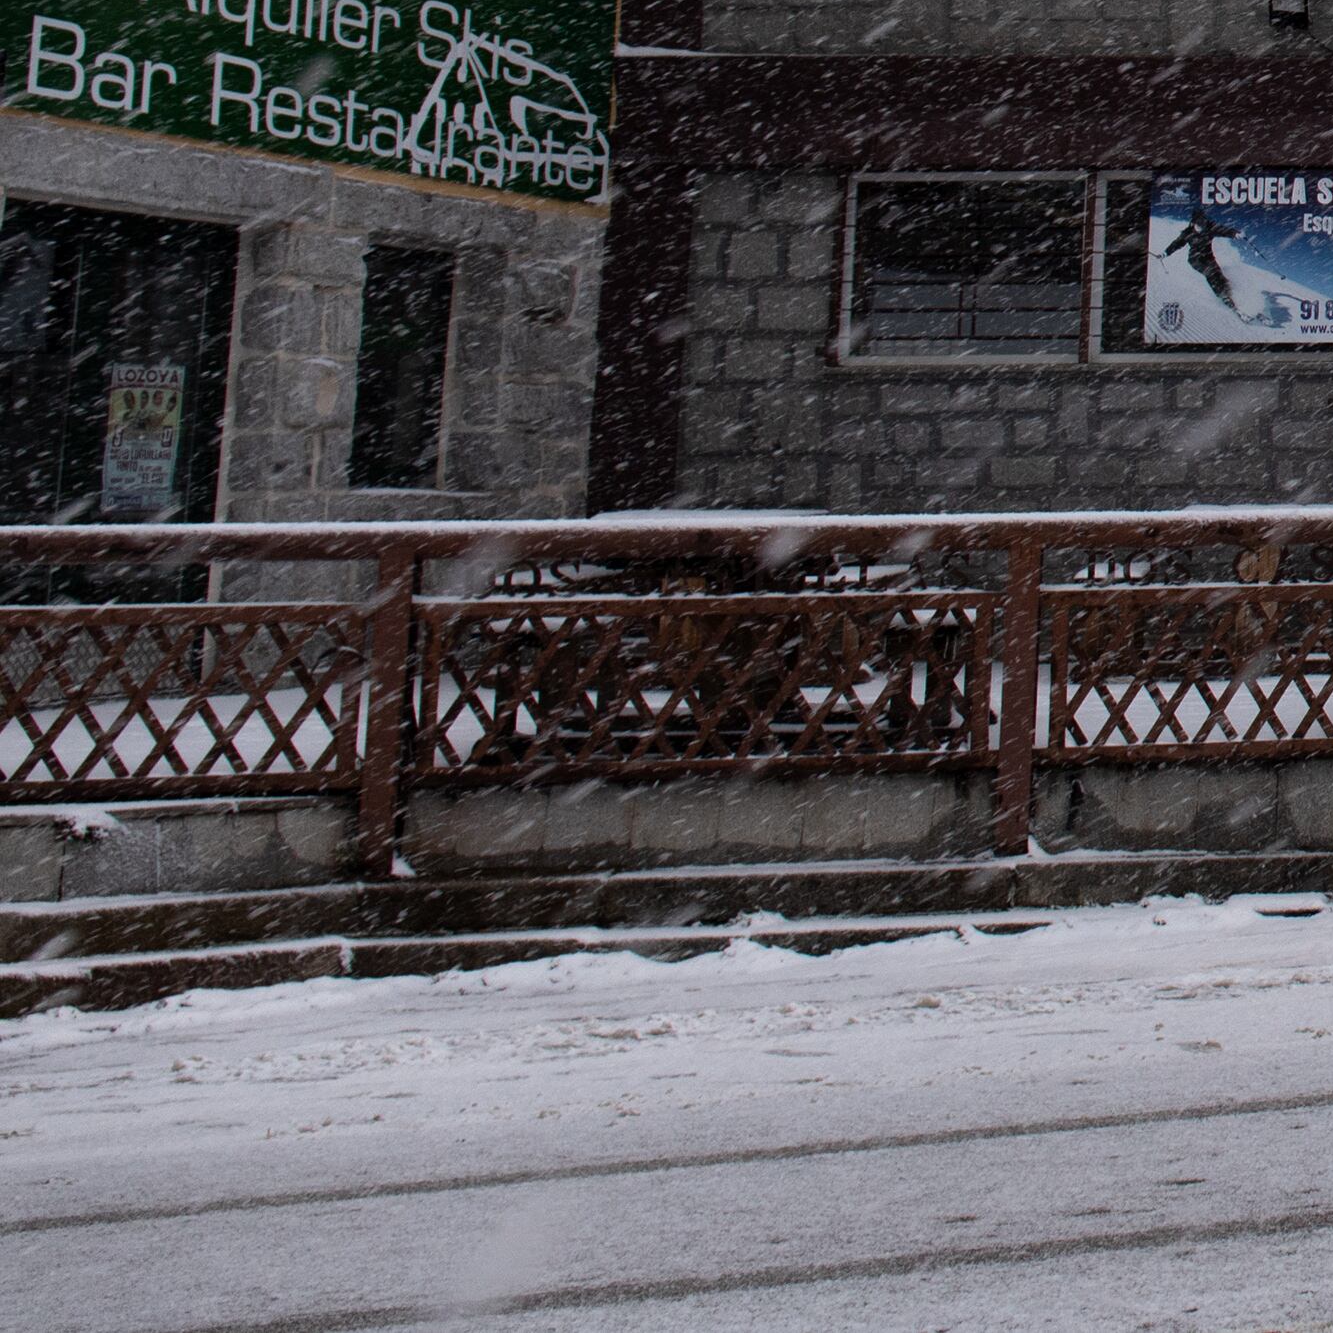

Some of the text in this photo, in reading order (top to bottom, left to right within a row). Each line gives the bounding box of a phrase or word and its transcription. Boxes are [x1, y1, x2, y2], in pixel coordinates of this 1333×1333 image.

[417, 0, 534, 87] Skis
[26, 14, 598, 192] Bar Restaurante
[1201, 176, 1307, 206] ESCUELA
[1299, 300, 1319, 320] 91
[117, 369, 179, 384] LOZOYA
